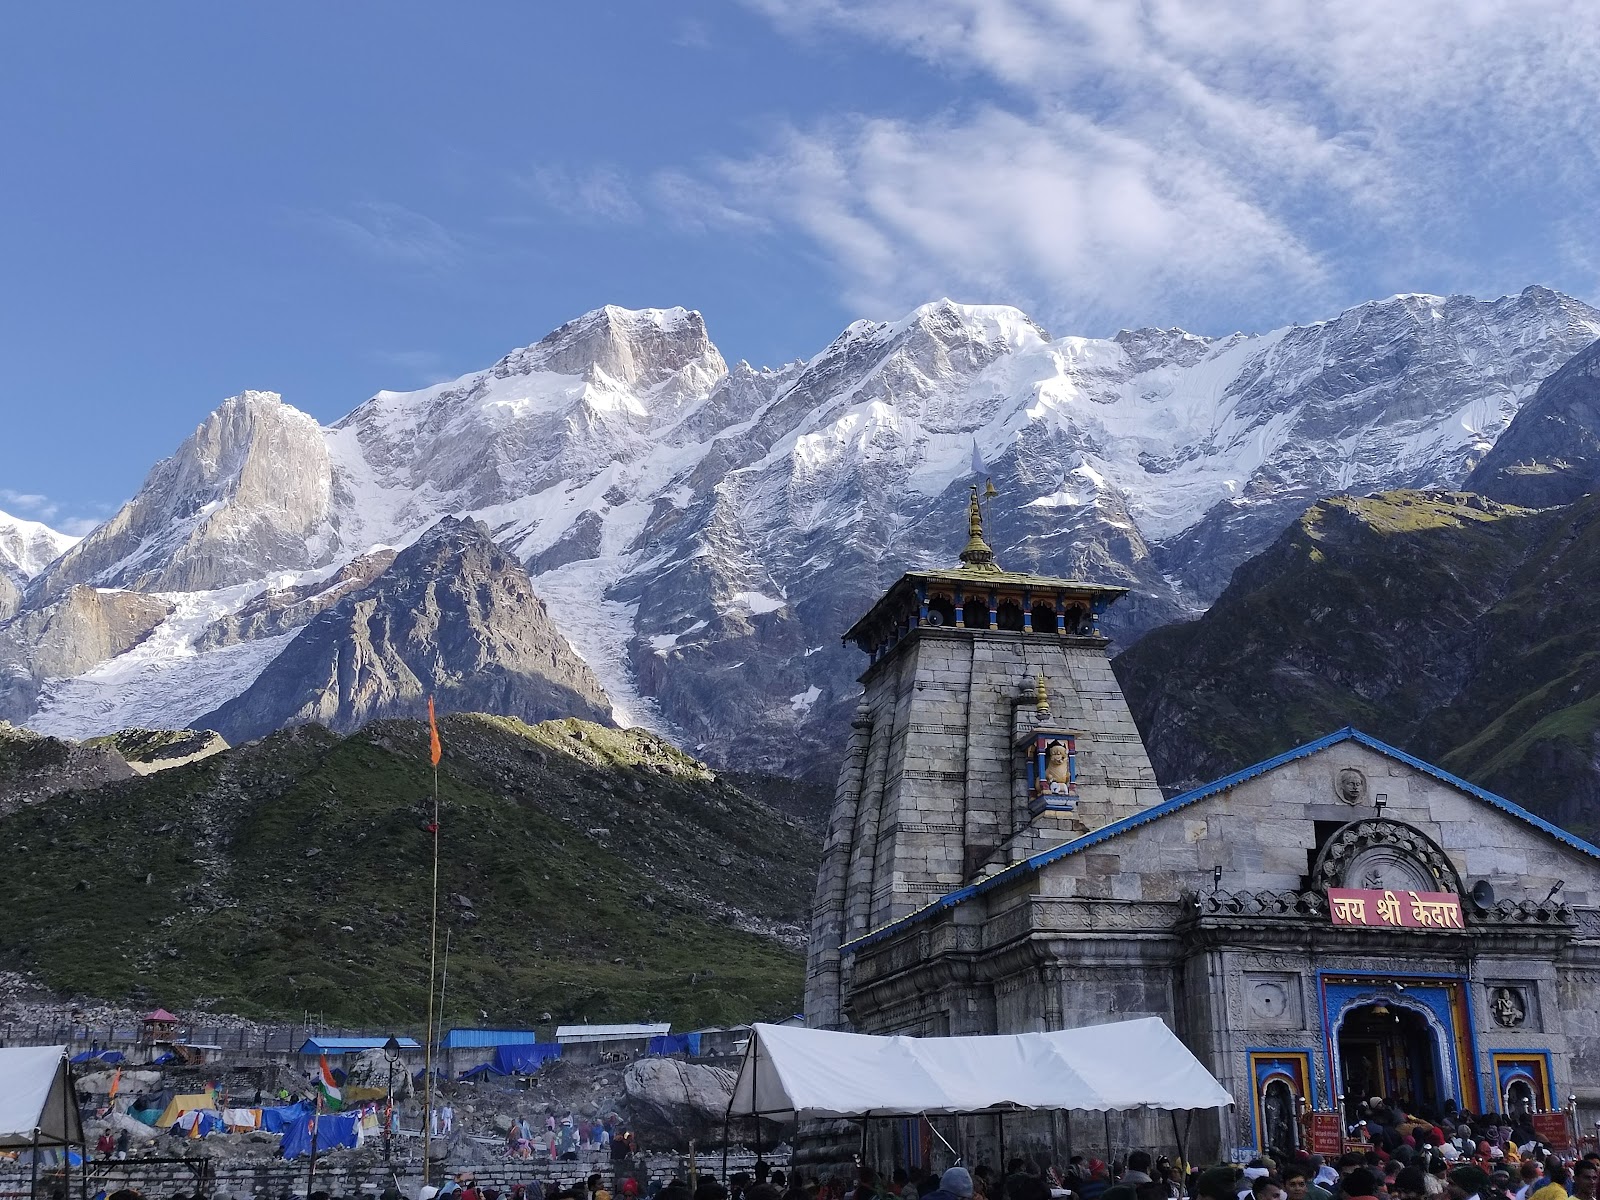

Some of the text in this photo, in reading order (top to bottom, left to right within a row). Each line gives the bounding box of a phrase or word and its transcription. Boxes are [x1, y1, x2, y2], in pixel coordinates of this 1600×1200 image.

[1333, 891, 1462, 928] जय श्री केदार
